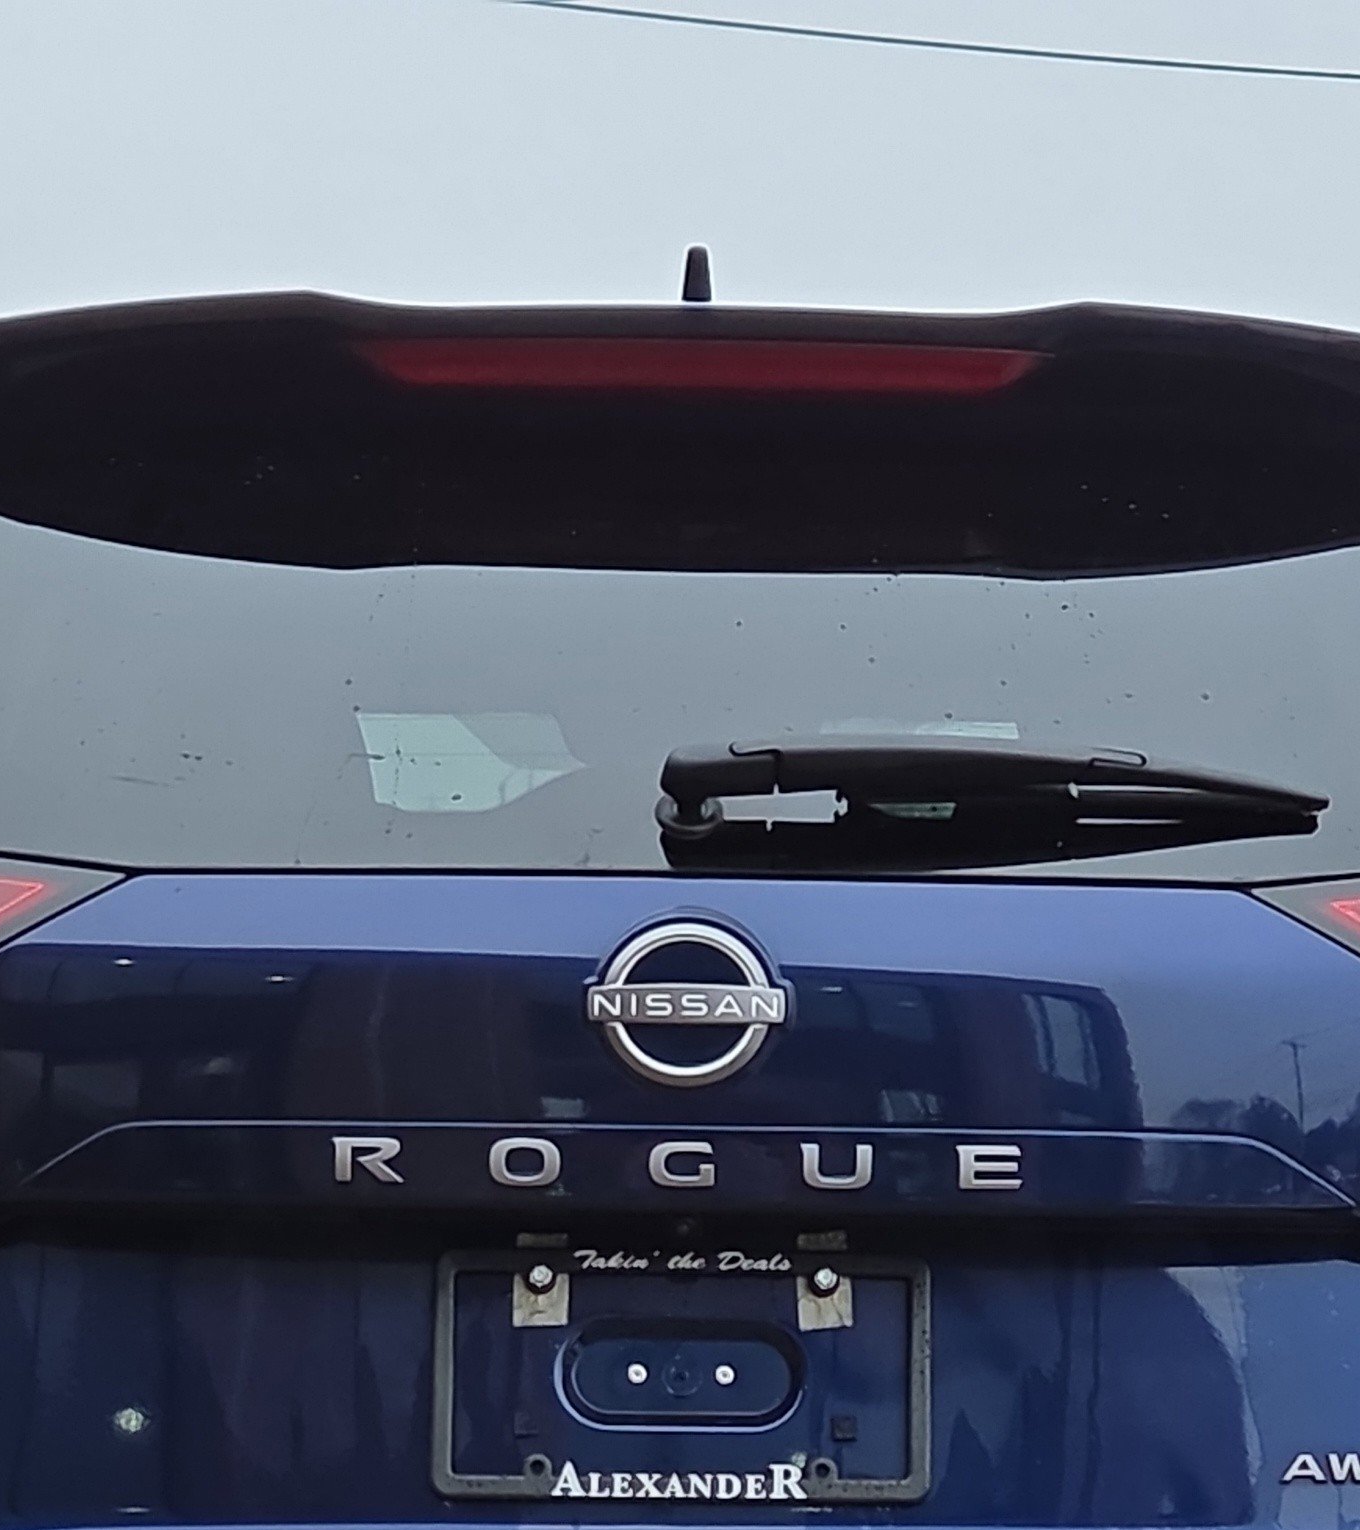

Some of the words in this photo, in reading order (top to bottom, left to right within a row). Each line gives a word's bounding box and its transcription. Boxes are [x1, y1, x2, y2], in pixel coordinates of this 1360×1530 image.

[592, 992, 779, 1019] NISSAN
[331, 1136, 1024, 1190] ROGUE
[667, 1251, 706, 1270] the
[717, 1250, 792, 1271] Deals
[550, 1461, 808, 1500] ALEXANDER
